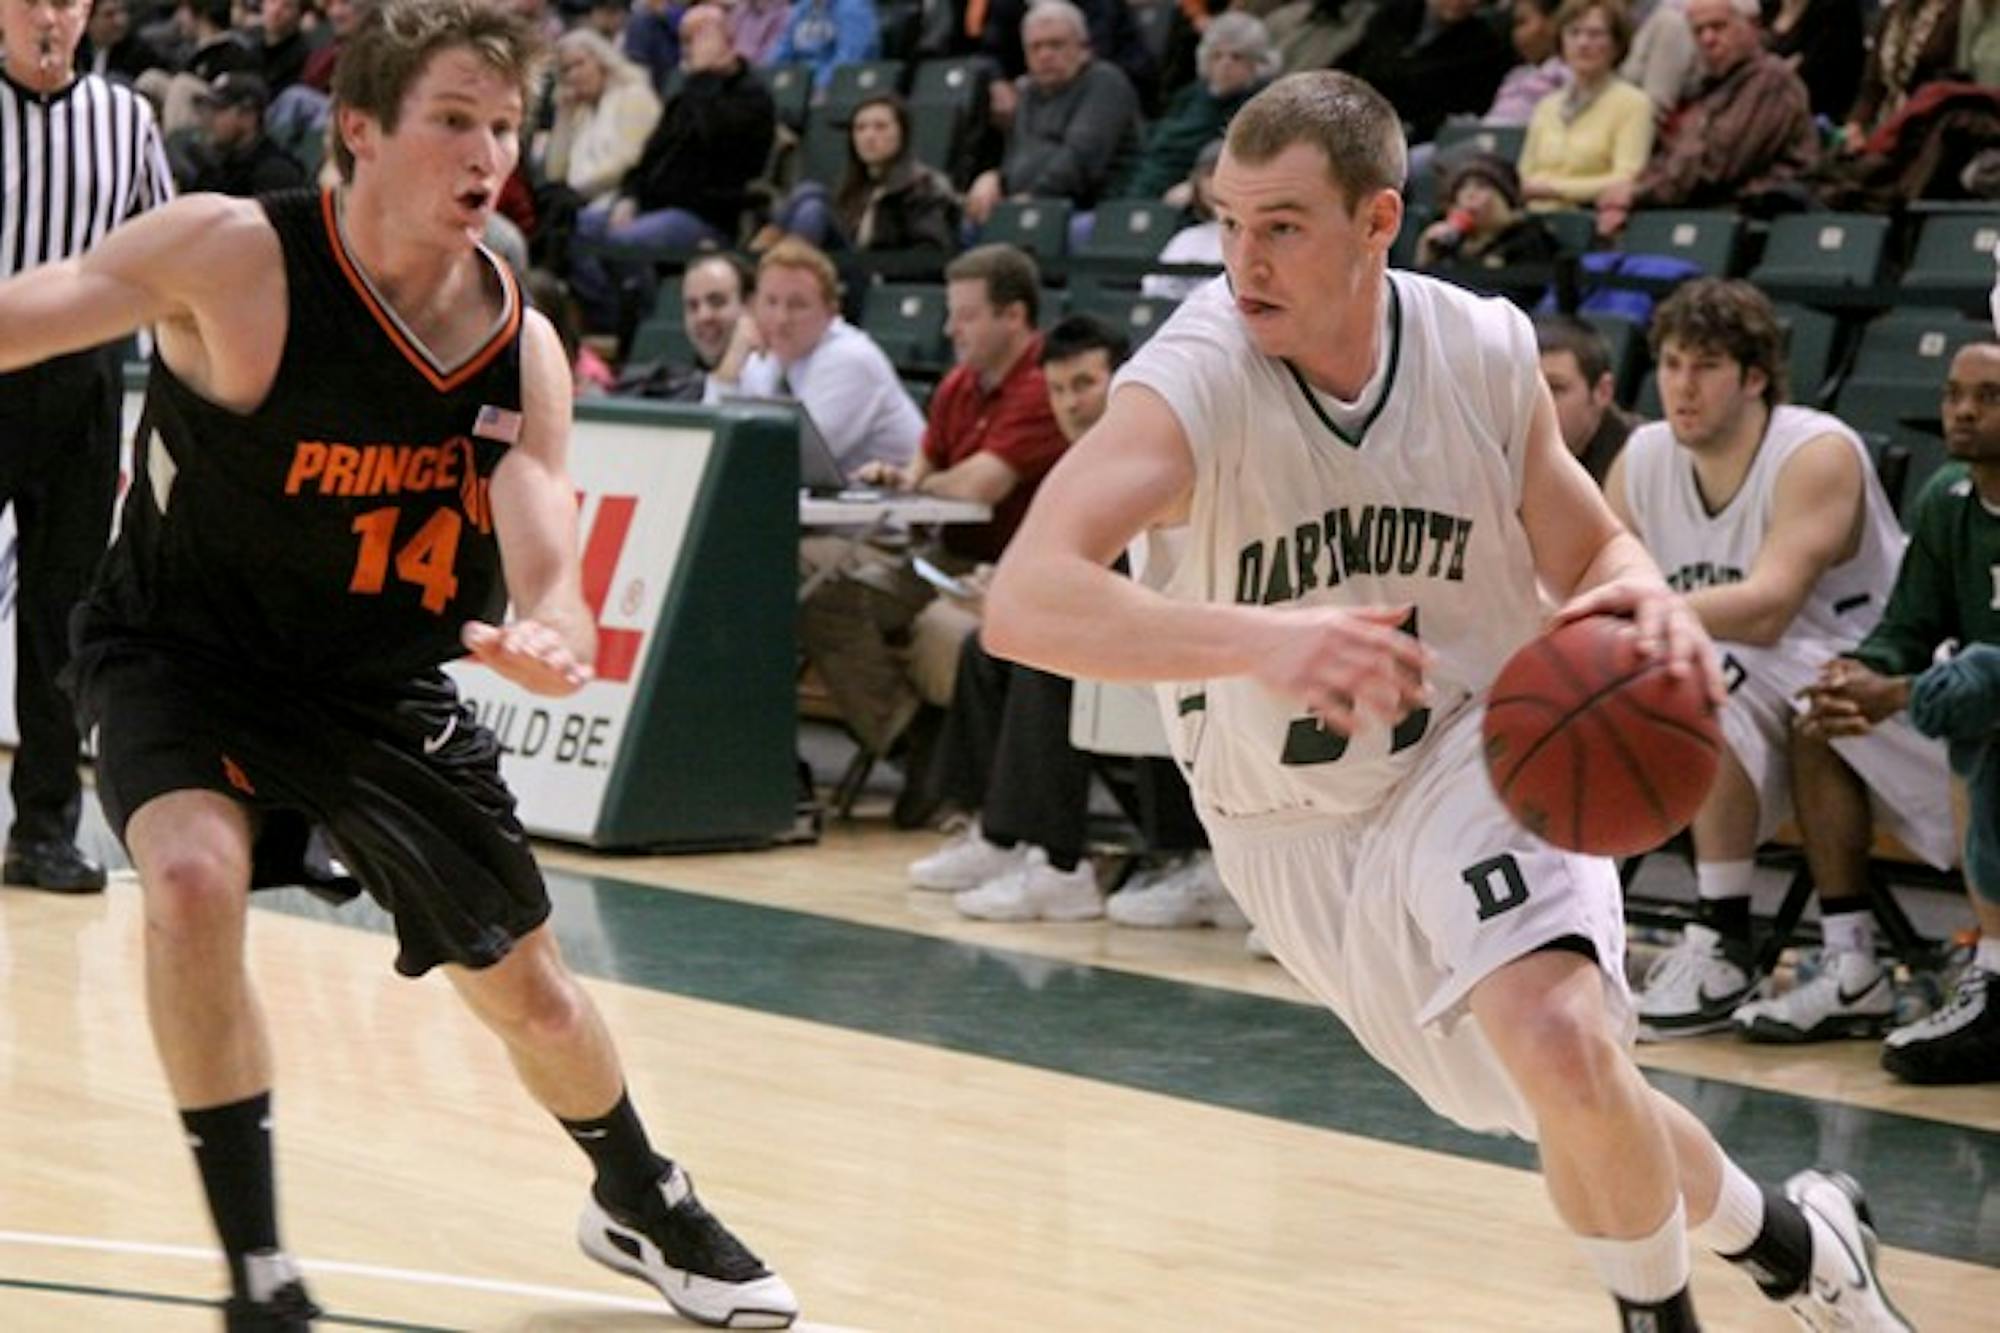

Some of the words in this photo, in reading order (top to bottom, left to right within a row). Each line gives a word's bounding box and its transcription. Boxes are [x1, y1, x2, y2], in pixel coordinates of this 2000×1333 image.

[349, 506, 462, 615] 14
[1235, 505, 1473, 606] DARTMOUTH
[1462, 852, 1530, 921] D
